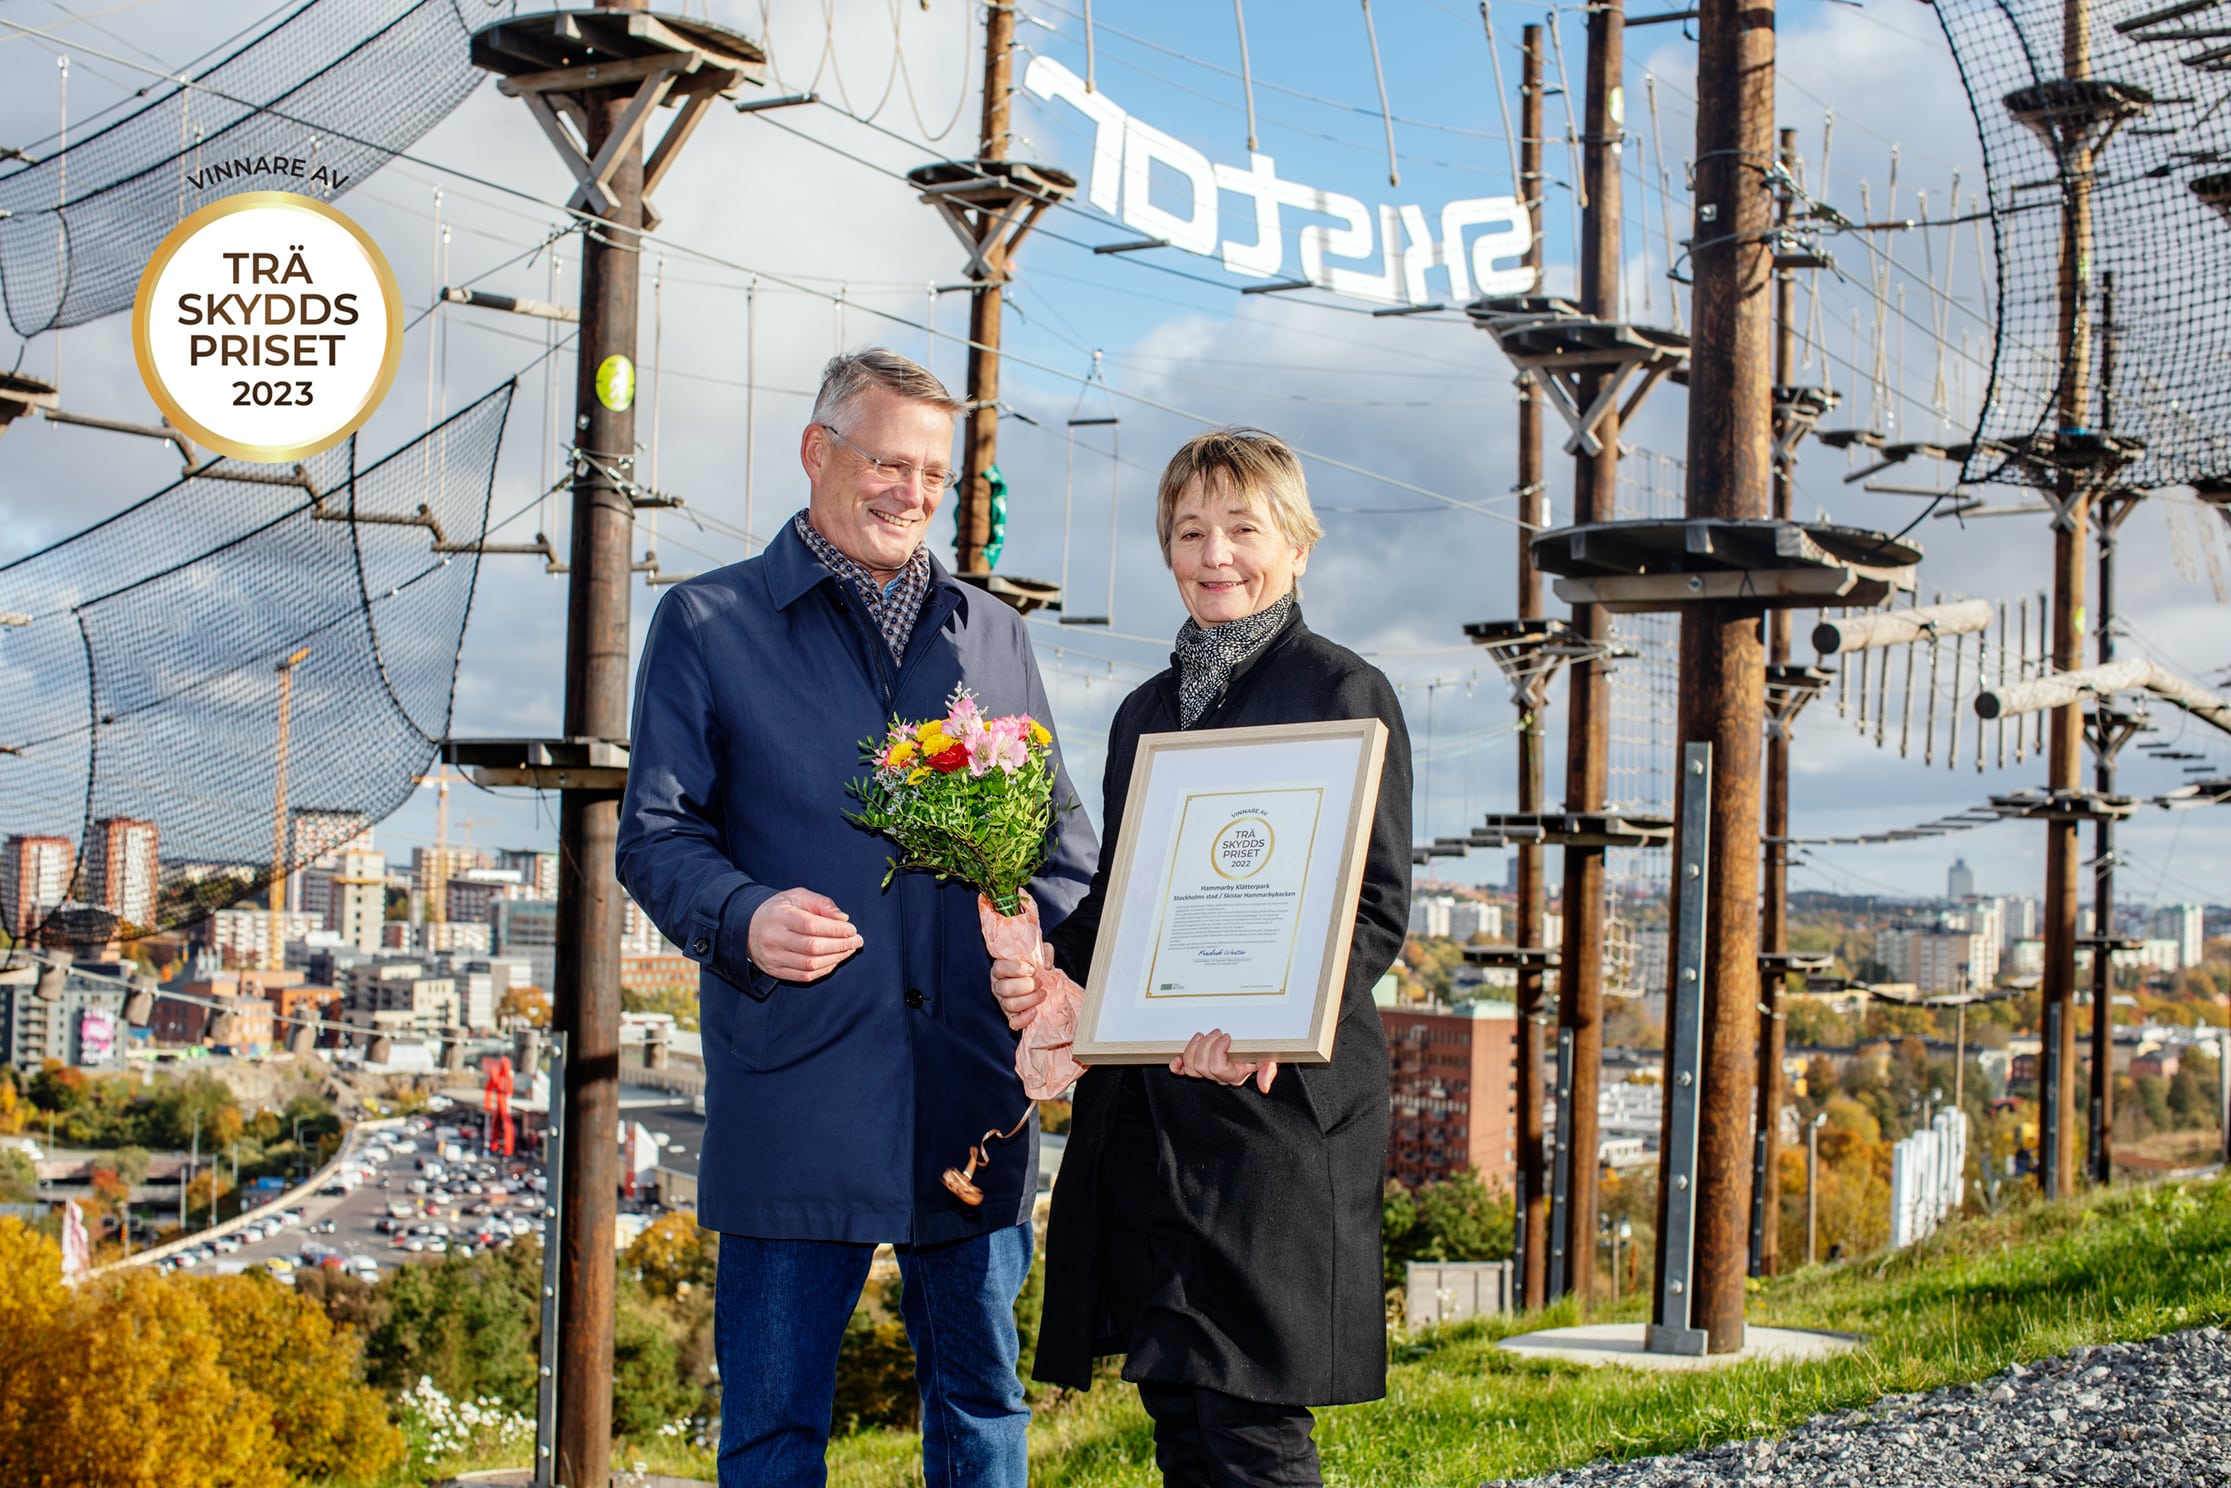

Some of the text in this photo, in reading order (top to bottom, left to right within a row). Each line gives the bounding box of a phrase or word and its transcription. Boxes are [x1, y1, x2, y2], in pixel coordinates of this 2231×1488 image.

[1231, 808, 1259, 818] VINNARE
[1235, 828, 1256, 839] TRÄ
[1222, 839, 1265, 849] SKYDDS
[1223, 849, 1260, 858] PRISET
[1231, 860, 1251, 868] 2022
[1235, 883, 1270, 891] Klätterpark
